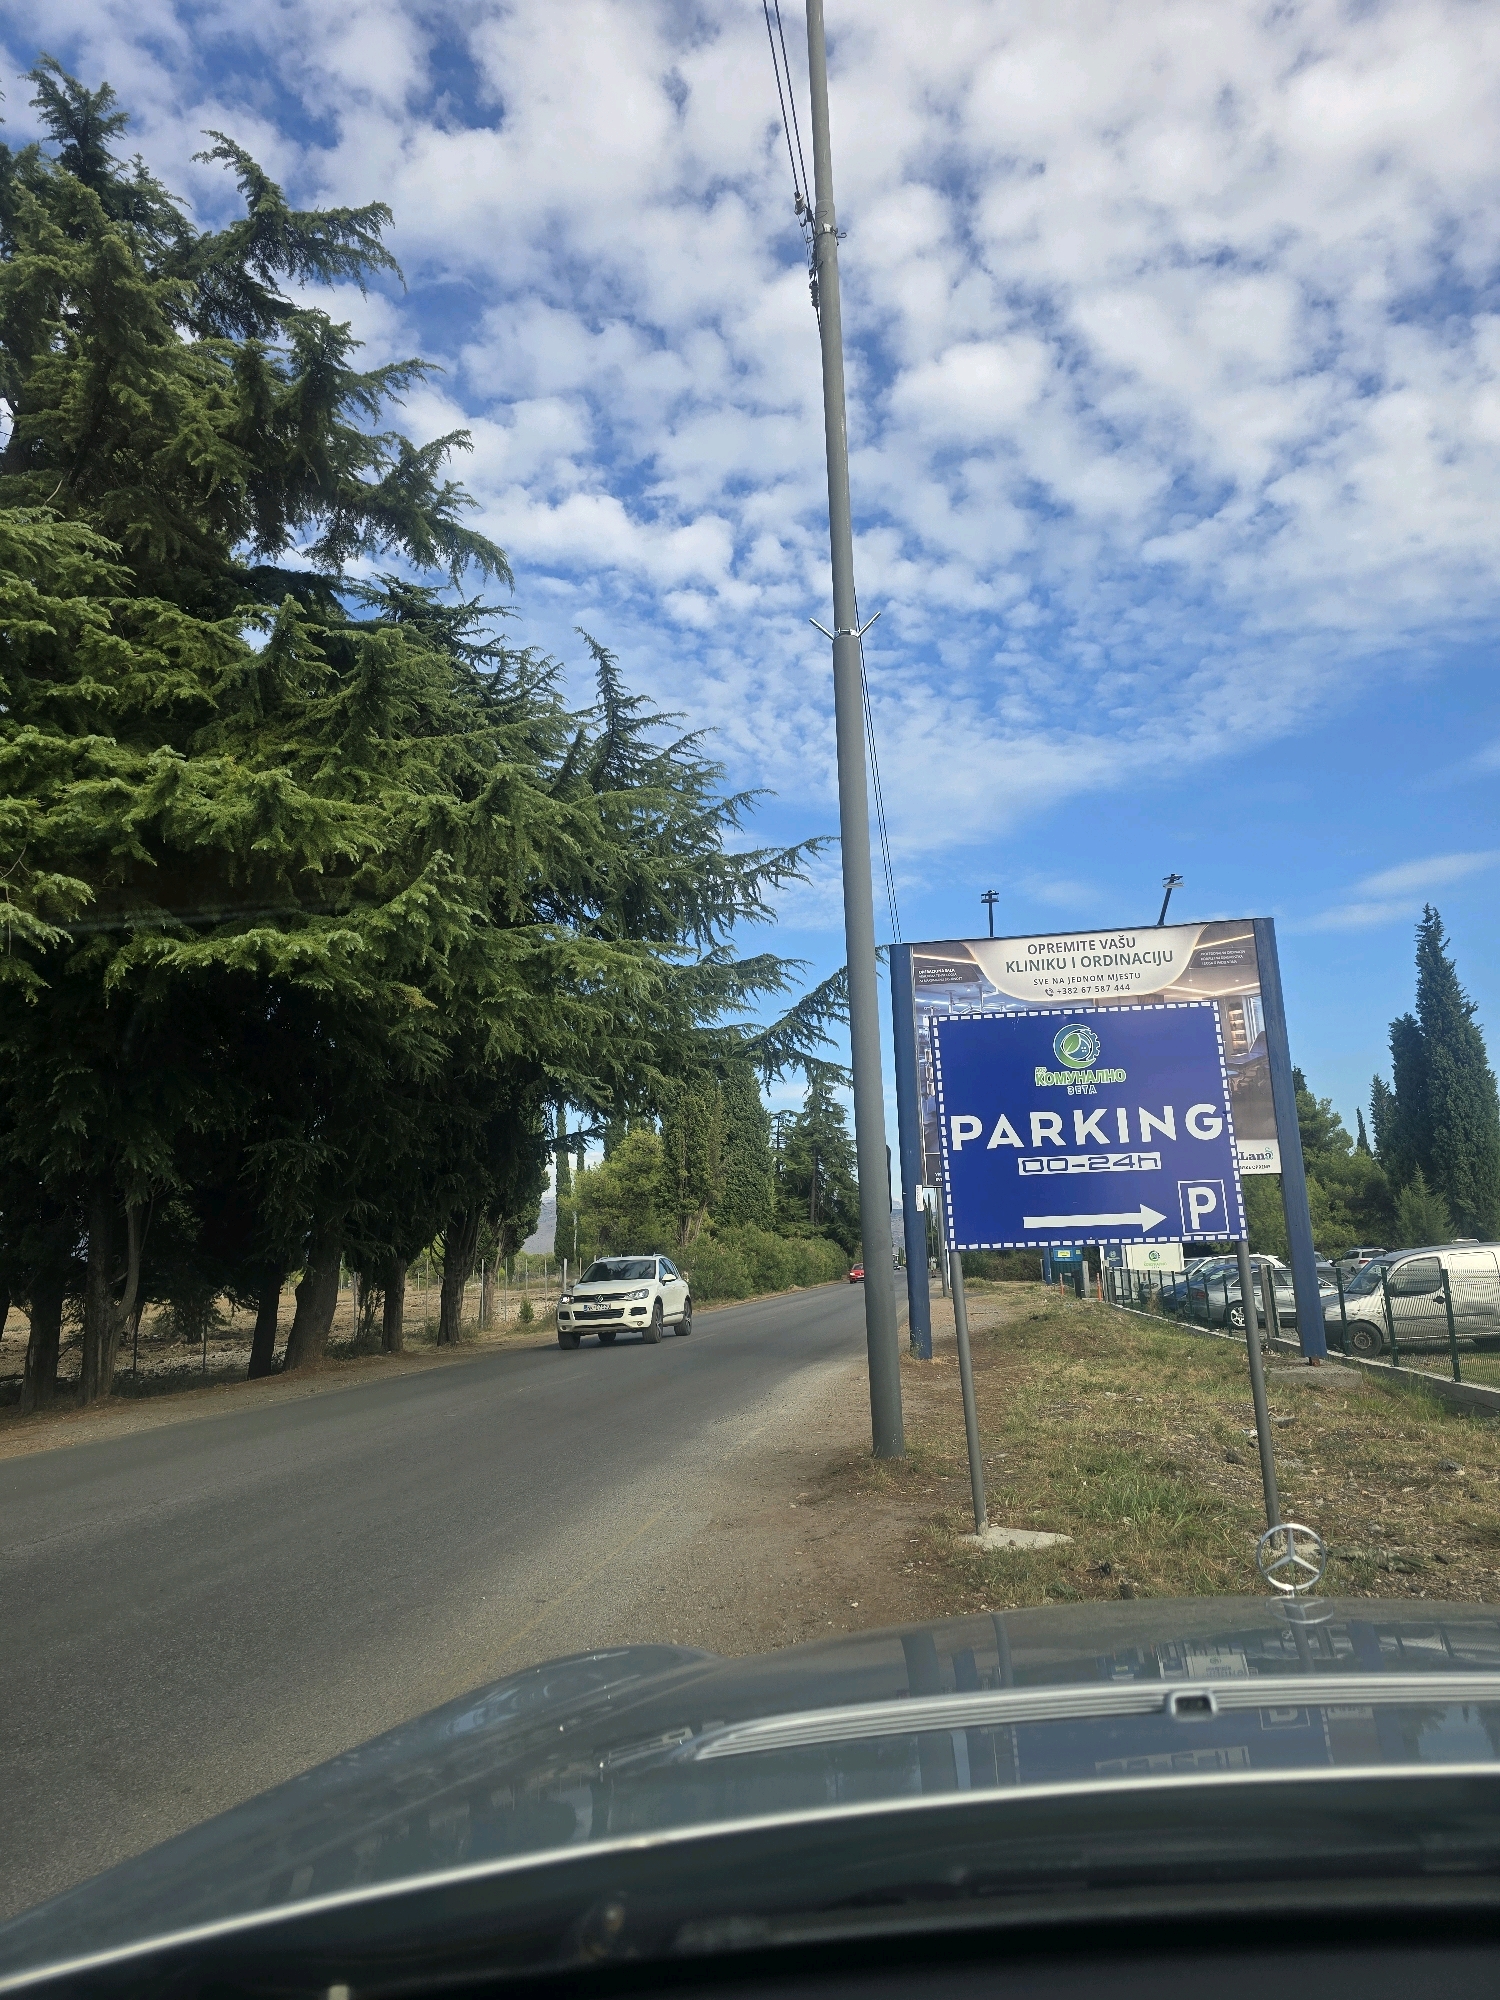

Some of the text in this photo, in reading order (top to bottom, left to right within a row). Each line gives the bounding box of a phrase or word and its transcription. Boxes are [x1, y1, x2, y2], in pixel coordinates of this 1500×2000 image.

[1027, 935, 1136, 955] OPREMITE VAŠU
[1006, 950, 1174, 973] KLINIKU I ORDINACIJU
[1033, 972, 1141, 986] SVE NA JEDNOM MJESTU
[1056, 986, 1078, 995] +382
[1081, 986, 1092, 994] 67
[1094, 985, 1110, 993] 587
[1035, 1069, 1126, 1086] КОМУНАЛНО
[950, 1103, 1223, 1151] PARKING
[1021, 1154, 1159, 1173] 00-24h
[1187, 1186, 1217, 1230] P
